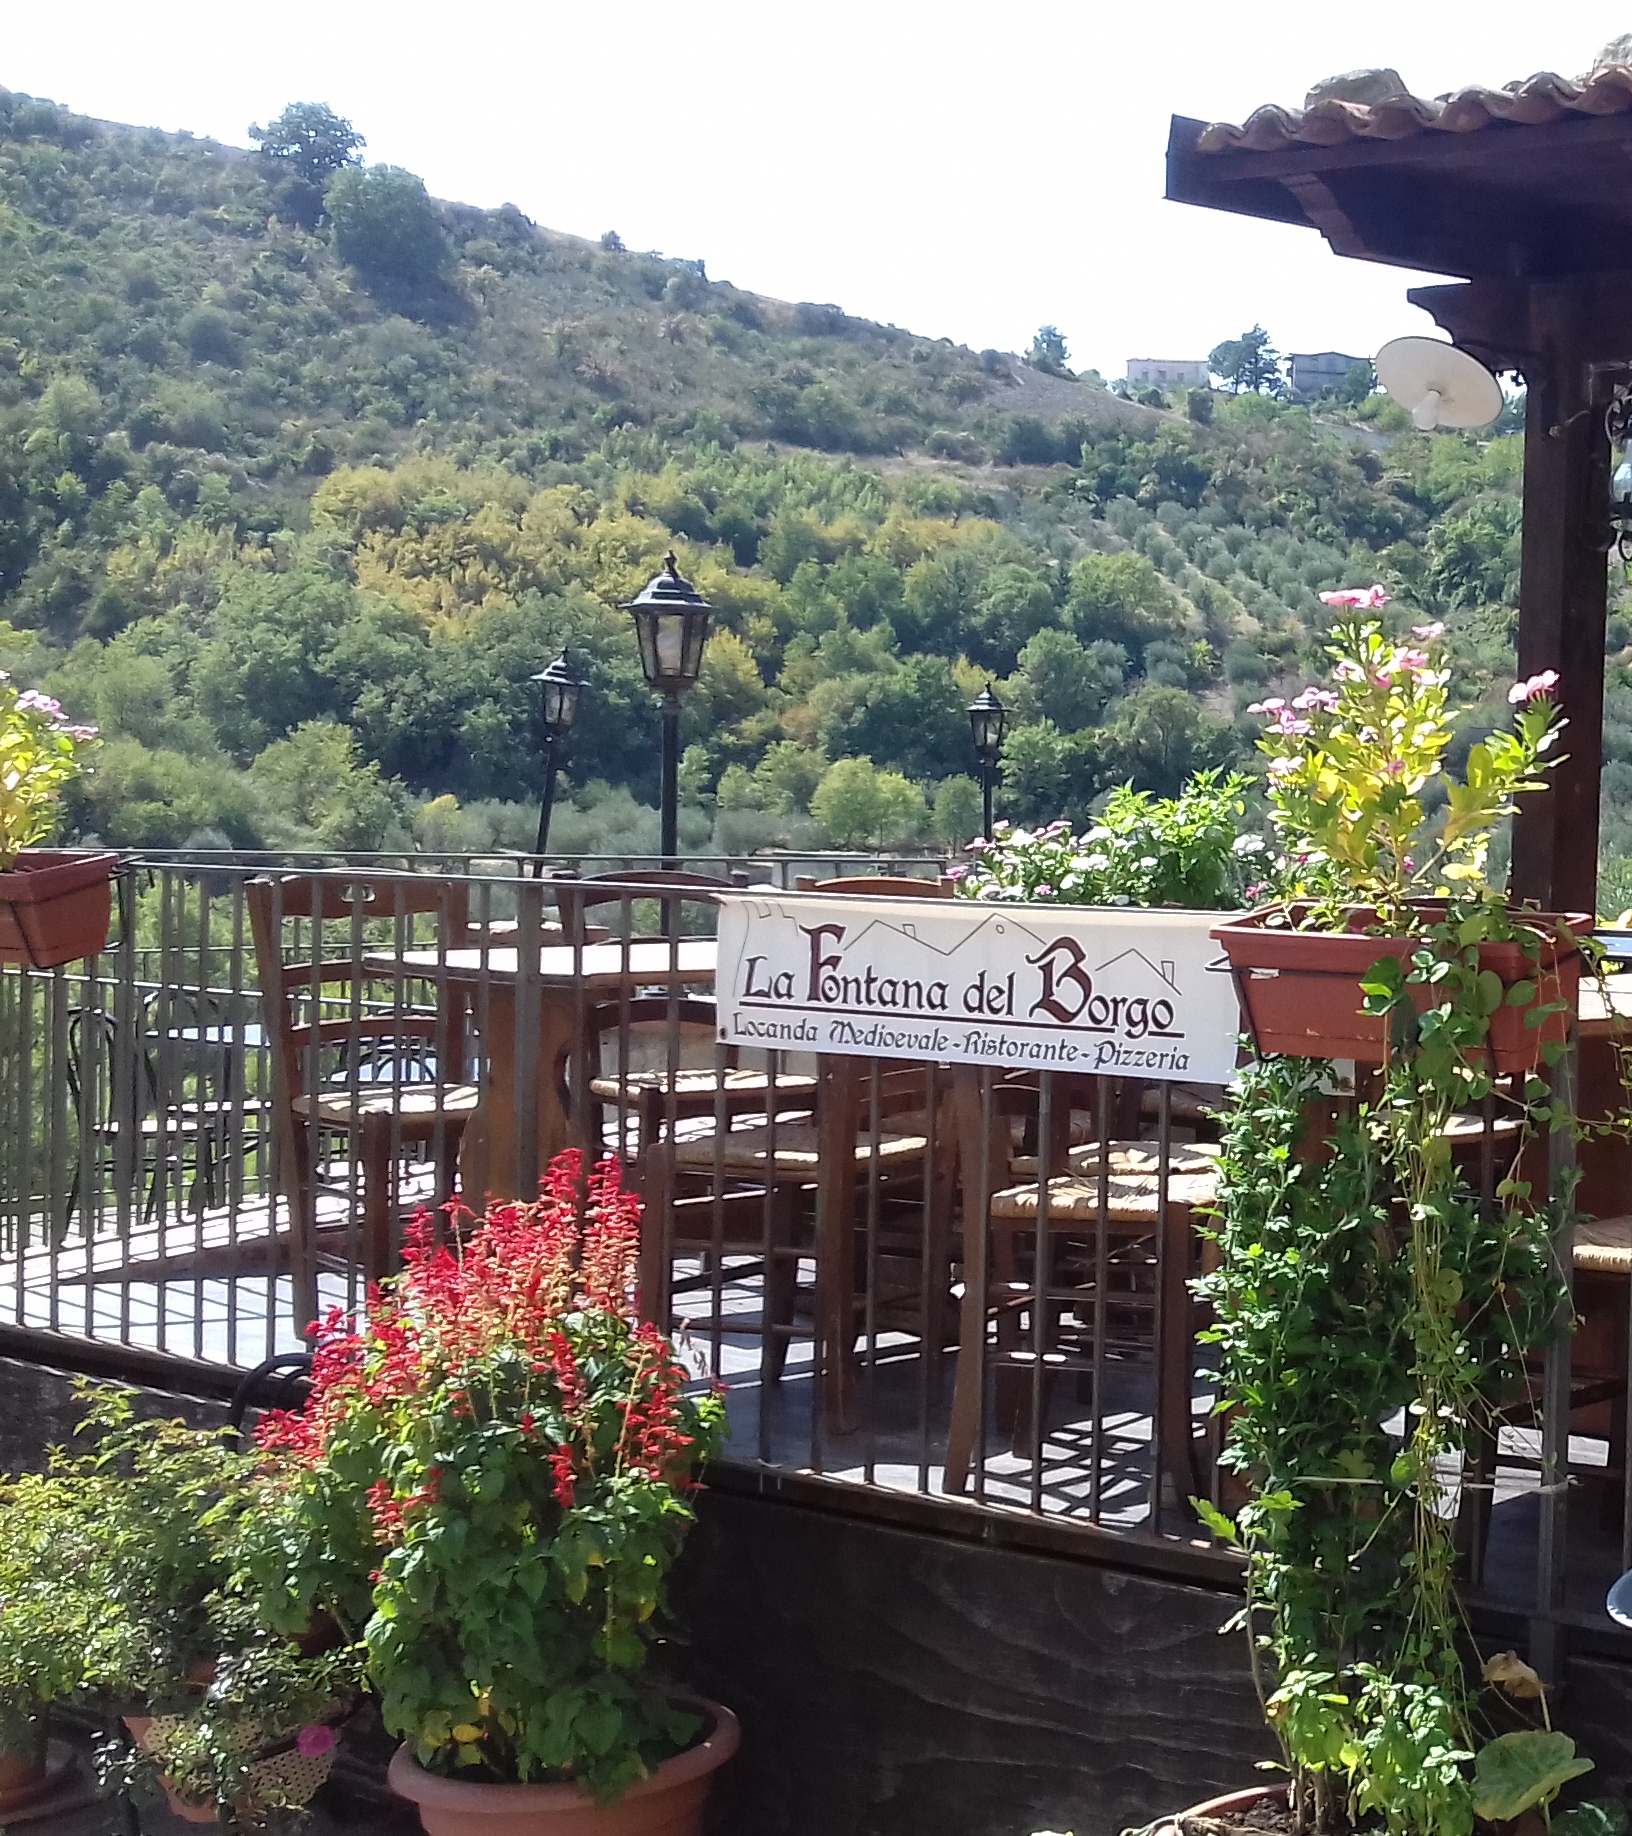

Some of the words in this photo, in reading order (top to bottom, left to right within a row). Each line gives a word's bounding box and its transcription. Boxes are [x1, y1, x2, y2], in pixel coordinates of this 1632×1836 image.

[742, 955, 796, 1000] La
[798, 923, 950, 1011] Fontana
[962, 969, 1016, 1017] del
[1024, 936, 1174, 1039] Borgo
[732, 1011, 819, 1042] Locanda
